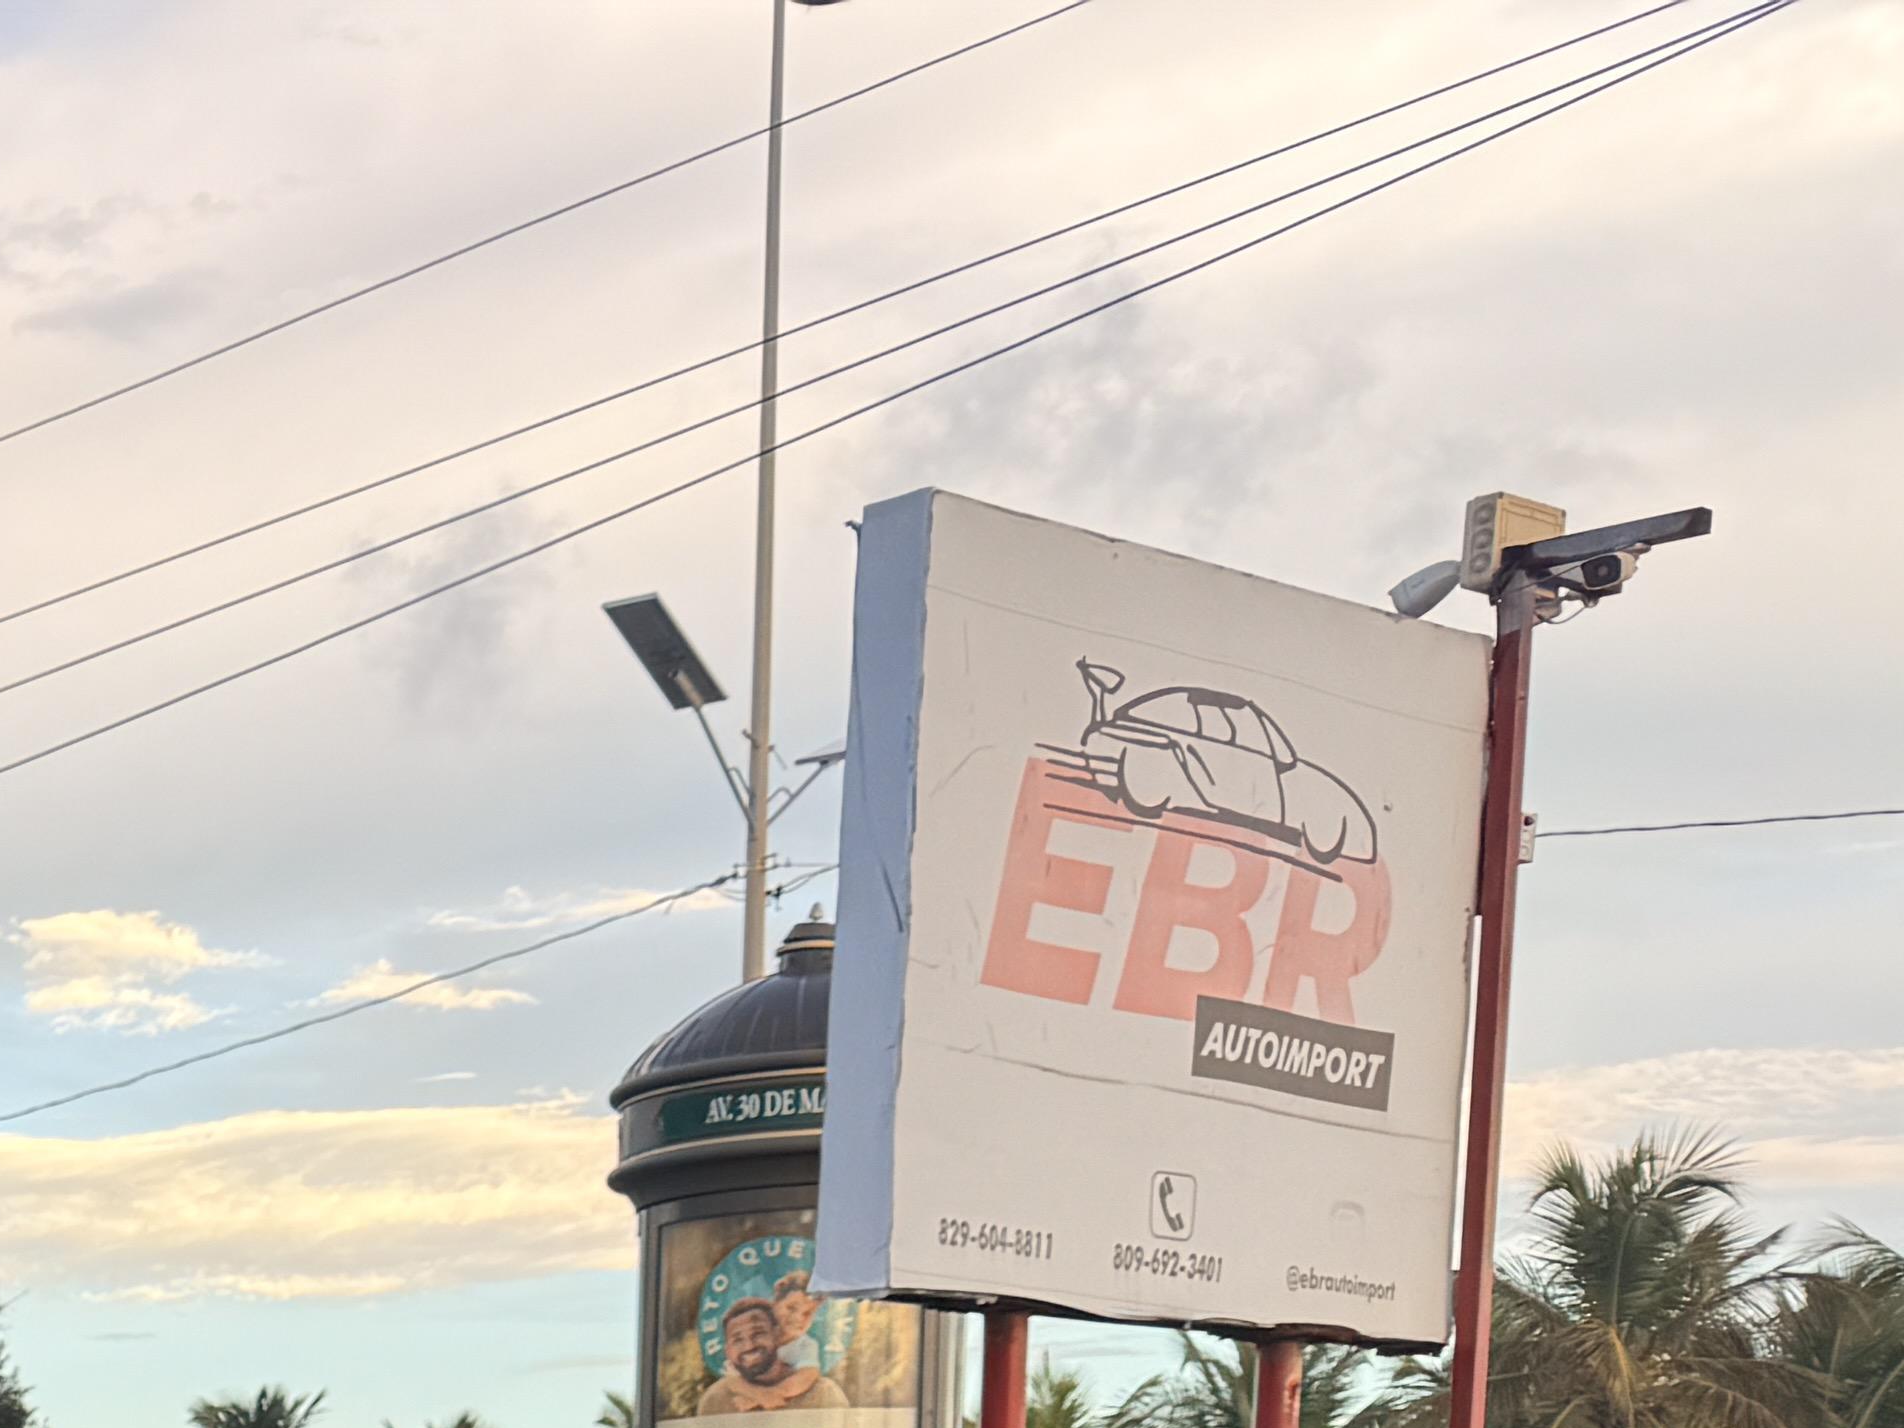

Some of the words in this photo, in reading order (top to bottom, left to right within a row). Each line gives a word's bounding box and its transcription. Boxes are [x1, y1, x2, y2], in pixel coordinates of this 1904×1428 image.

[979, 757, 1391, 1024] EBR
[1200, 1021, 1385, 1090] AUTOIMPORT
[705, 1094, 733, 1124] AV.
[736, 1093, 760, 1121] 30
[763, 1088, 796, 1117] DE
[798, 1087, 826, 1114] M
[1113, 1243, 1223, 1283] 809-692-3401
[1286, 1265, 1396, 1302] @ebrautoimport
